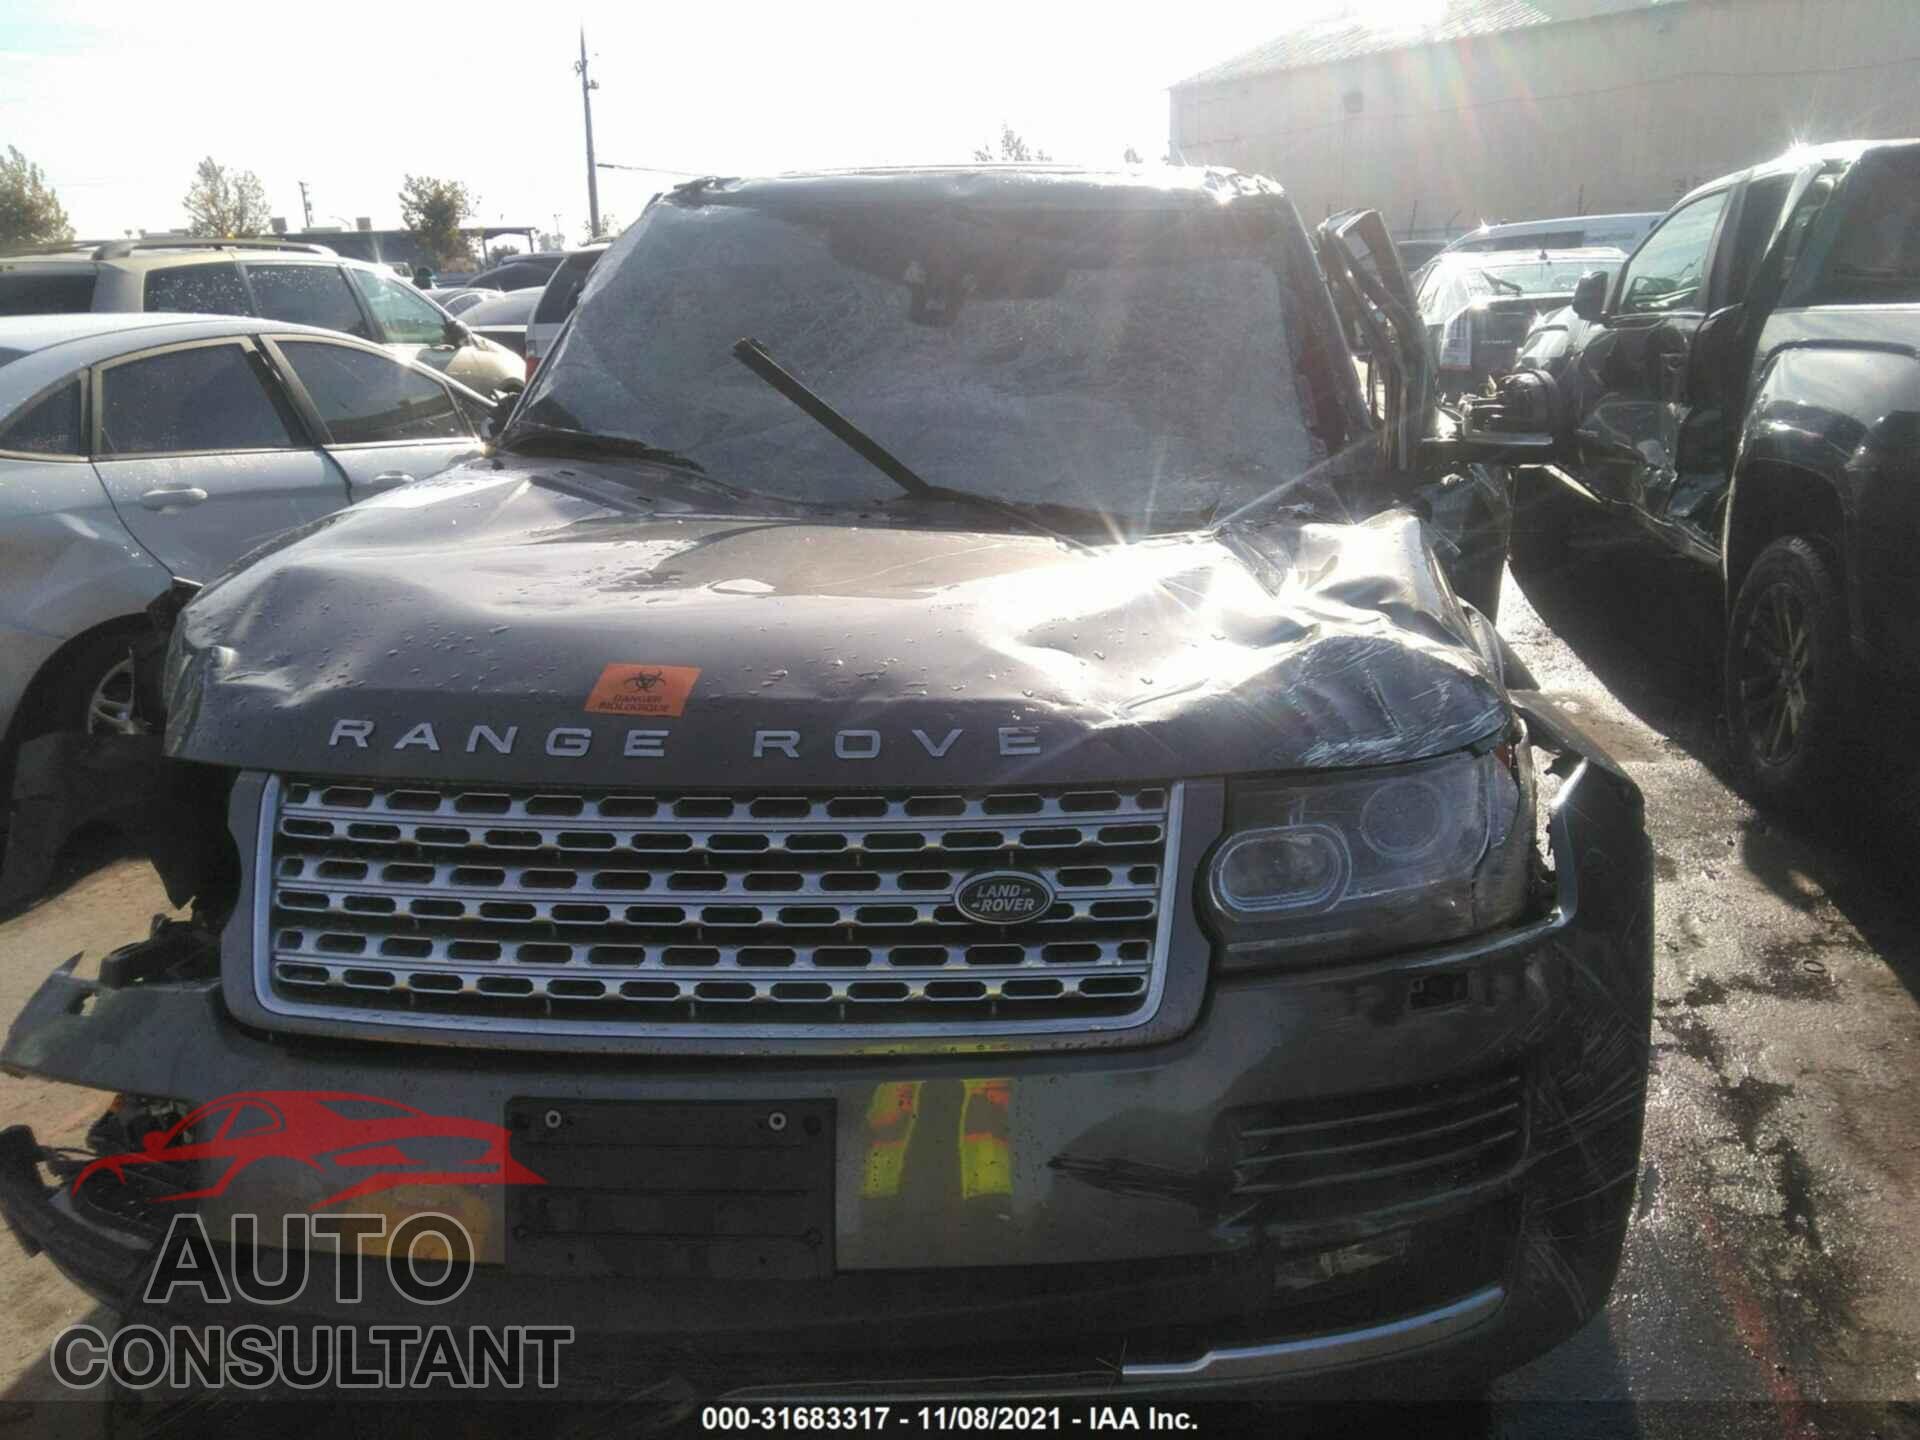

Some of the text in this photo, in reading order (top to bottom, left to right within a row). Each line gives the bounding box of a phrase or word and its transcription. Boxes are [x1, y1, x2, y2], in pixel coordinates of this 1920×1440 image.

[327, 718, 1041, 759] RANGE ROVE
[976, 884, 1022, 898] LAND
[980, 898, 1035, 912] ROVER
